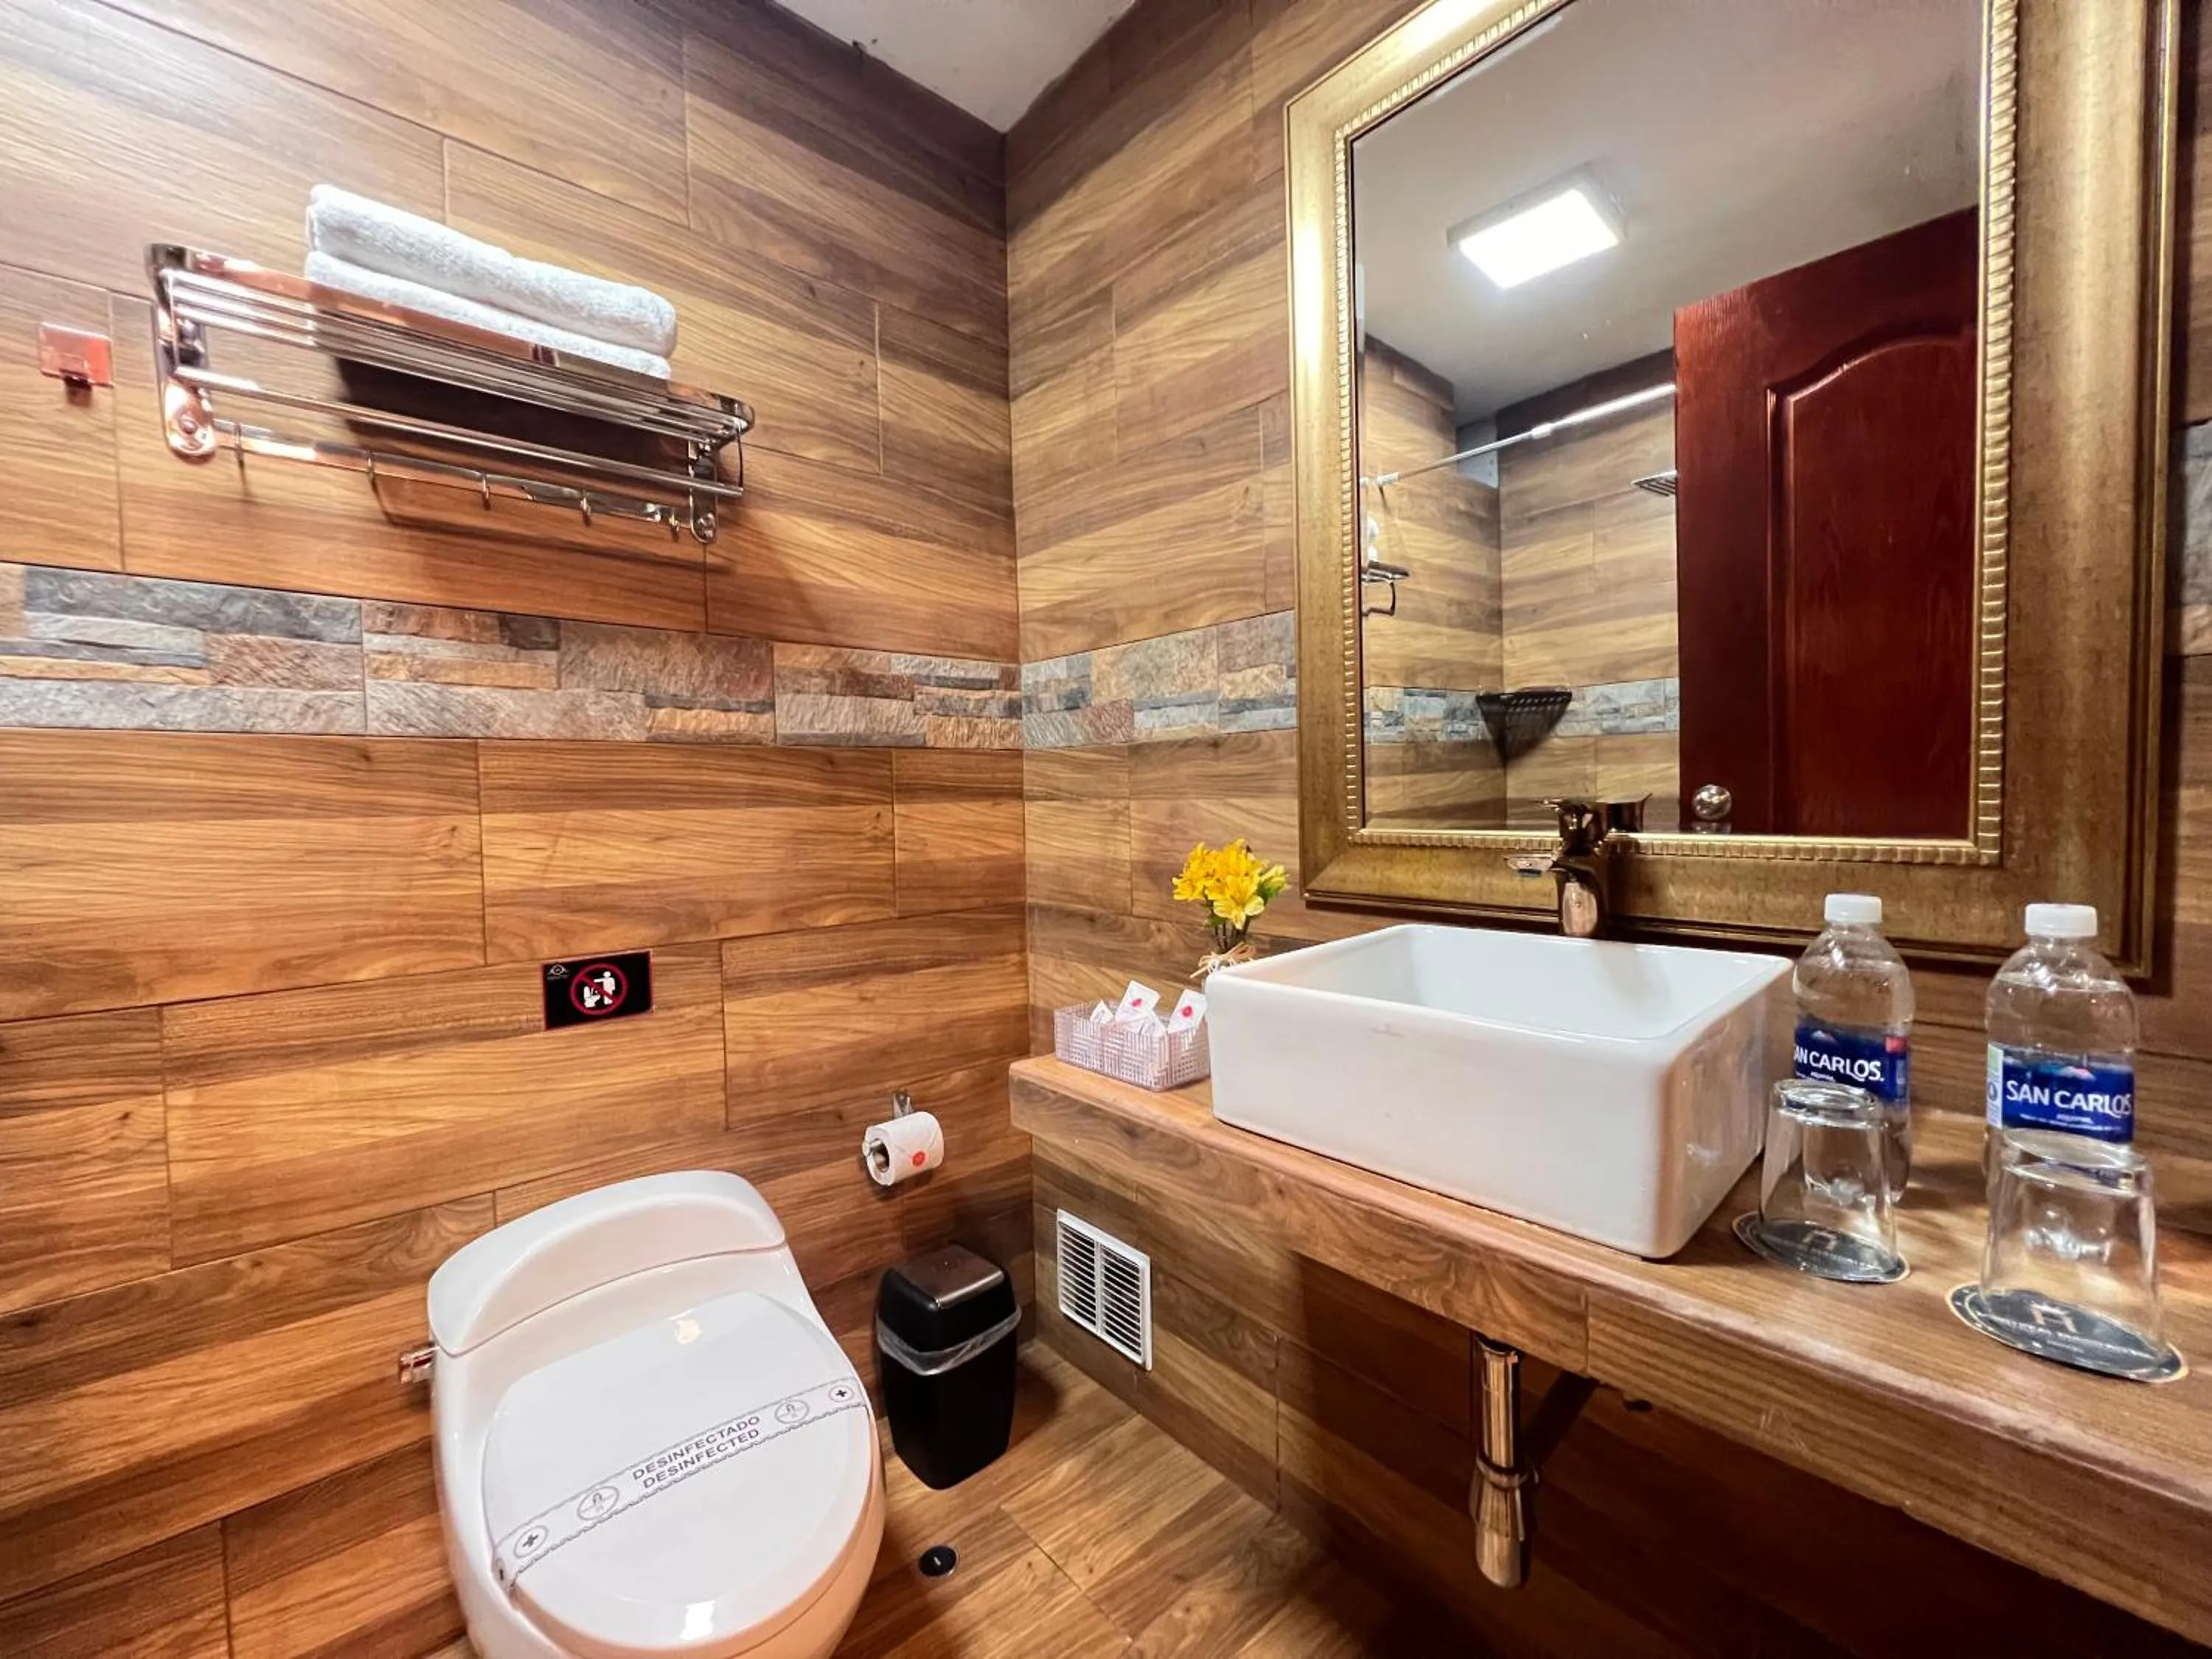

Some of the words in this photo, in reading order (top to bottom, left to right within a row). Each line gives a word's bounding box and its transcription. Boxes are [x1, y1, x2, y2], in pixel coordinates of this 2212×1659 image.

[1794, 1044, 1808, 1064] AN
[2006, 1080, 2050, 1106] SAN
[2054, 1090, 2132, 1119] CARLOS
[632, 1416, 760, 1480] DESINFECTADO
[643, 1429, 759, 1488] DESINFECTED
